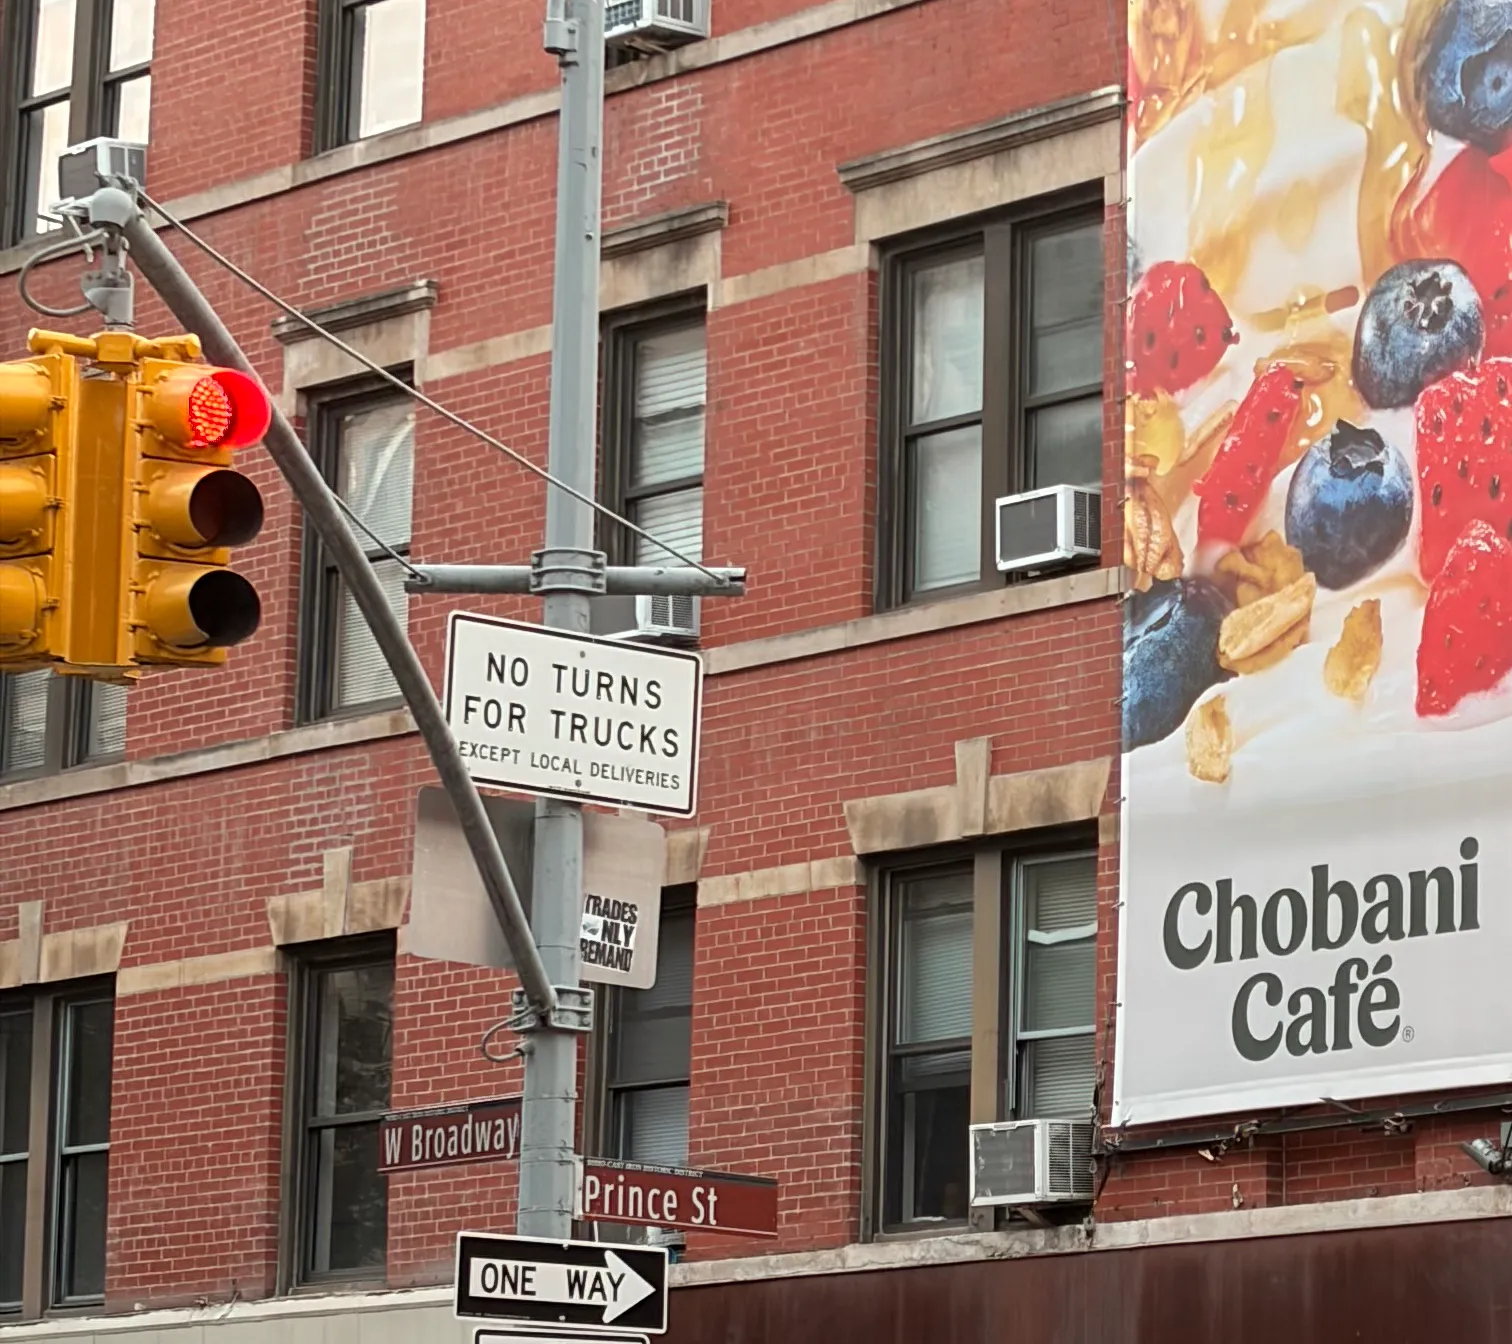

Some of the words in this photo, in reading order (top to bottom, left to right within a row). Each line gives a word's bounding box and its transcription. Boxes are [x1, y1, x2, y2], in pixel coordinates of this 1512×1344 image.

[486, 652, 528, 687] NO
[551, 663, 661, 709] TURNS
[464, 695, 526, 734] FOR
[550, 709, 679, 758] TRUCKS
[459, 740, 520, 765] EXCEPT
[530, 752, 582, 775] LOCAL
[590, 762, 680, 790] DELIVERIES
[1163, 837, 1480, 970] Chobani
[1232, 954, 1400, 1061] Café
[385, 1127, 402, 1165] W
[412, 1113, 519, 1162] Broadway
[585, 1175, 678, 1221] Prince
[691, 1186, 718, 1225] St
[481, 1263, 536, 1296] ONE
[567, 1268, 626, 1302] WAY
